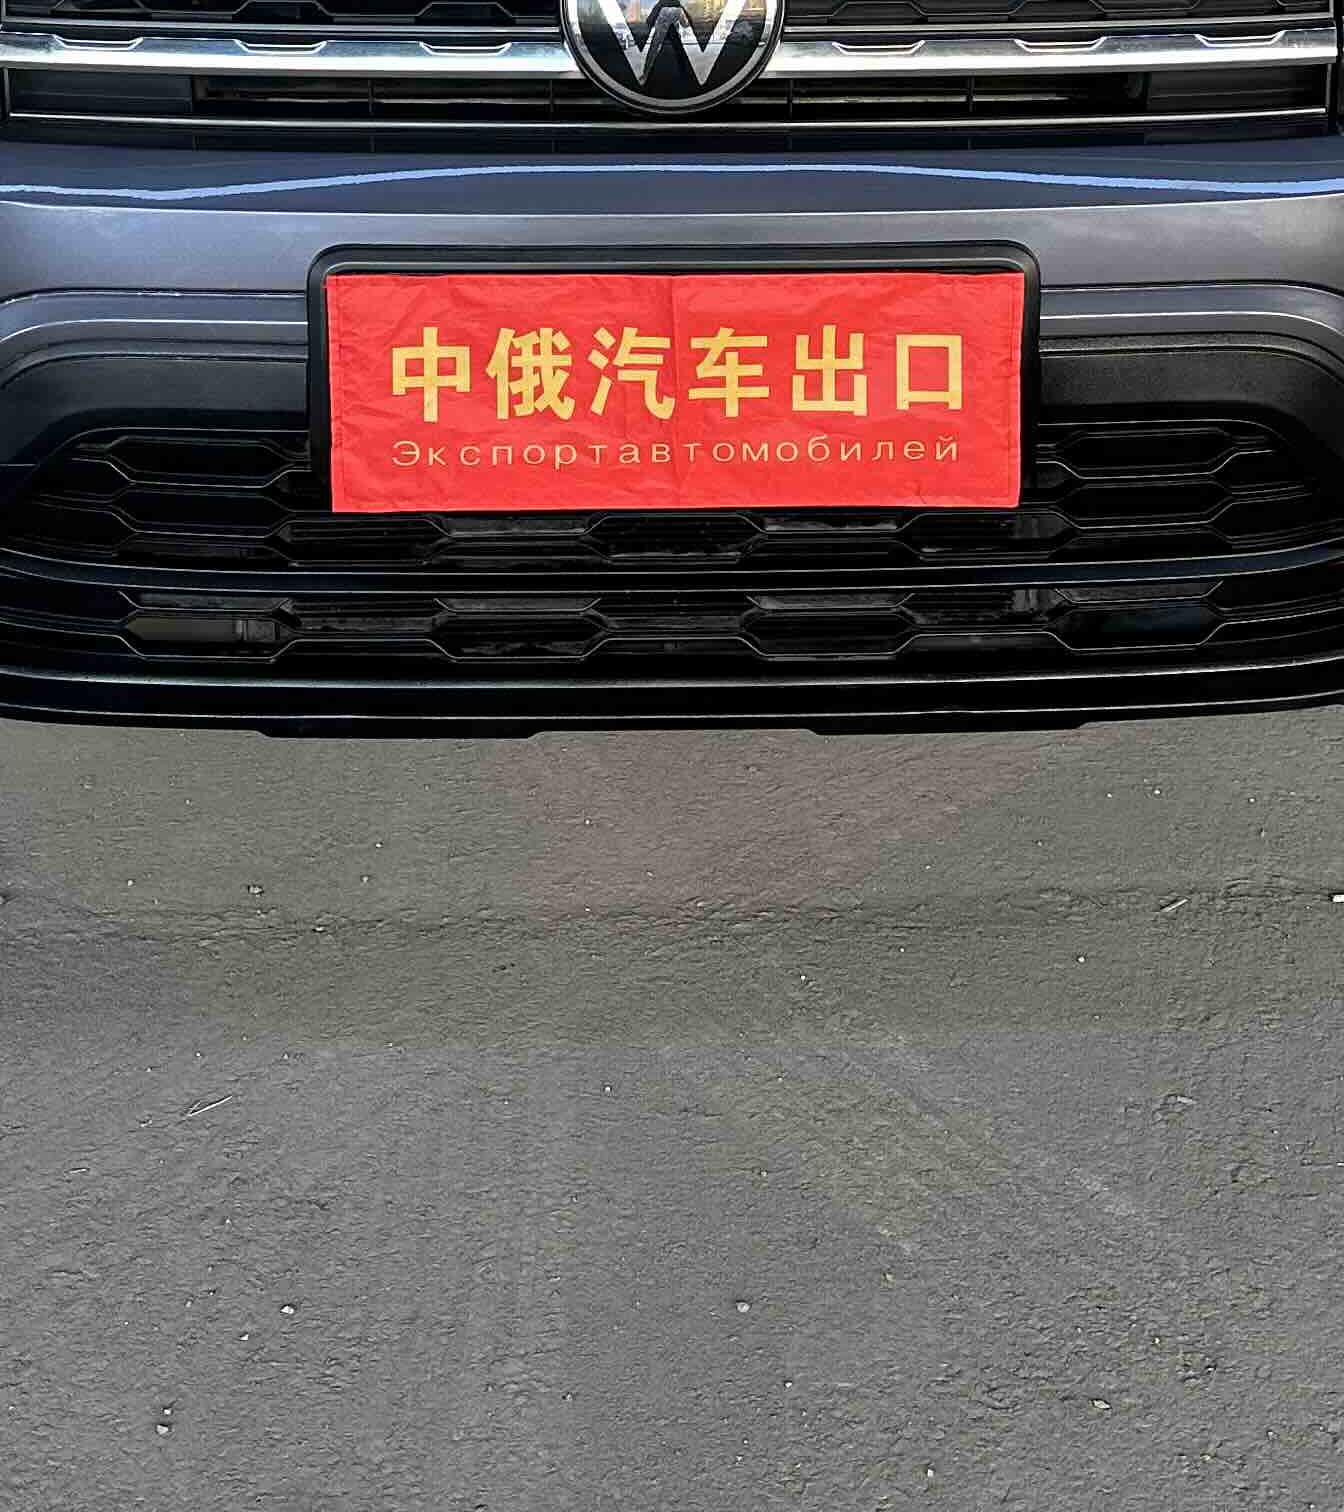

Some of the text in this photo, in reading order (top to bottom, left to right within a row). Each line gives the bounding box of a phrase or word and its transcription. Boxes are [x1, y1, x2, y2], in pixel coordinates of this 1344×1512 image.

[391, 324, 964, 423] 中俄汽车出口
[392, 432, 959, 471] Экспортавтомобилей
